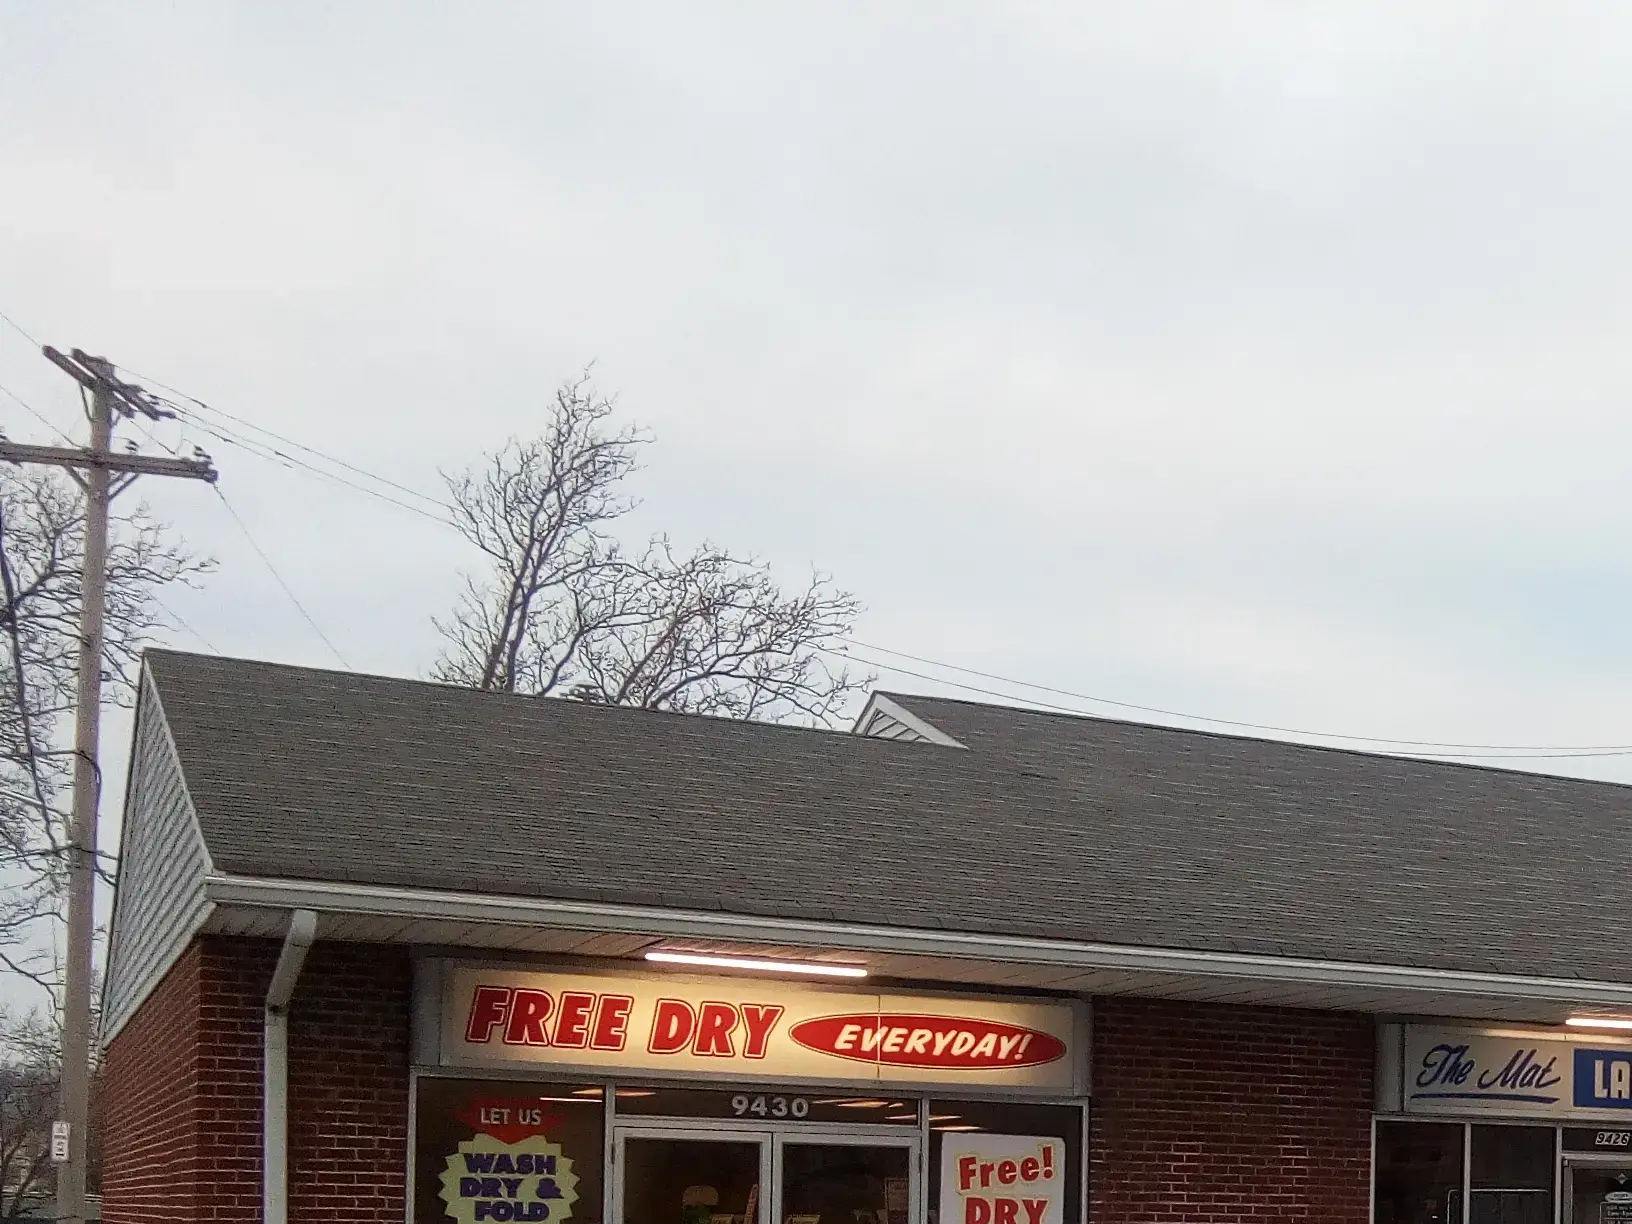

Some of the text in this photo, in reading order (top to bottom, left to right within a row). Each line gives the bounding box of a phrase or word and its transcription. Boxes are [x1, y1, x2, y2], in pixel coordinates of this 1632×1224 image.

[465, 986, 785, 1059] FREE DRY
[834, 1024, 1033, 1060] EVERYDAY!
[1416, 1043, 1562, 1090] The Mat
[480, 1107, 542, 1126] LET US
[731, 1095, 810, 1118] 9430
[1595, 1132, 1630, 1146] 9426
[463, 1153, 557, 1175] WASH
[959, 1145, 1053, 1190] Free!
[460, 1177, 564, 1199] DRY &
[474, 1200, 550, 1222] FOLD
